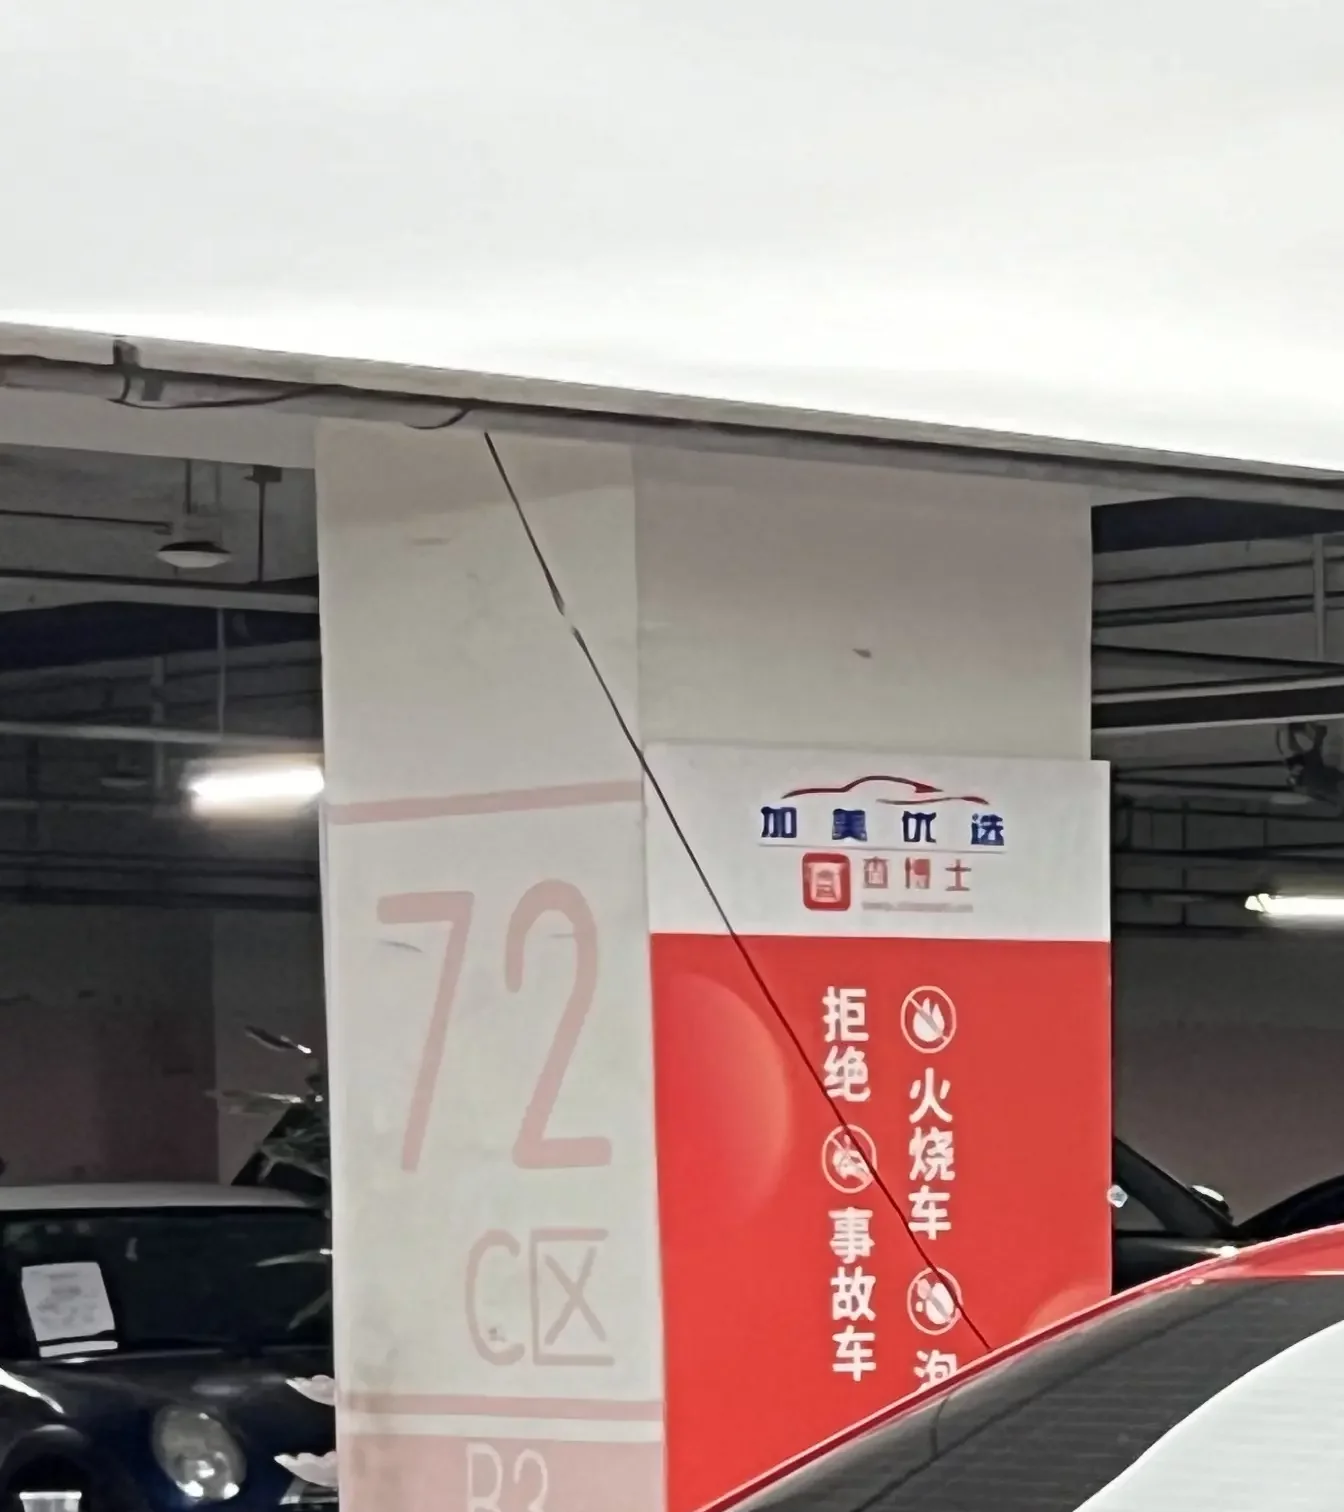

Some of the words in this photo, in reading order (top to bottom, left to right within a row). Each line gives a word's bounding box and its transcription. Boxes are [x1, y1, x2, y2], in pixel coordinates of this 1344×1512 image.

[376, 878, 613, 1173] 72
[821, 985, 872, 1102] 拒绝
[907, 1066, 956, 1241] 火烧车
[464, 1228, 616, 1368] C区
[827, 1206, 878, 1382] 事故车
